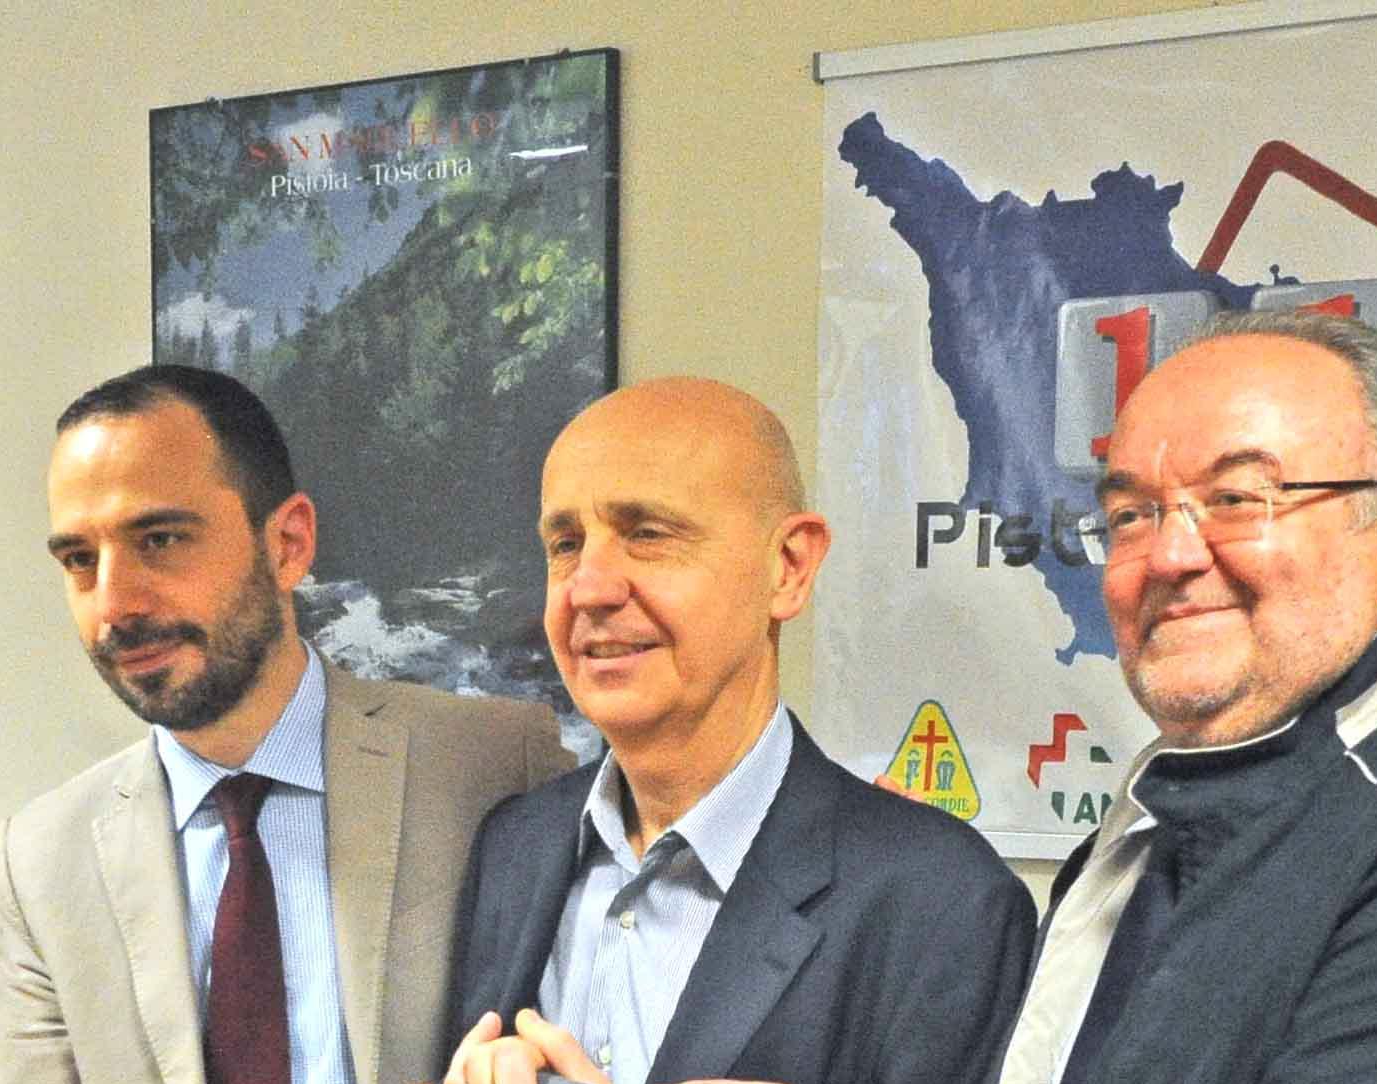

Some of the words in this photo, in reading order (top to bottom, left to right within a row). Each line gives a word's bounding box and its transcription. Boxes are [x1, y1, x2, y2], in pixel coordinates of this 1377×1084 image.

[270, 170, 349, 198] Pistoia
[369, 156, 473, 187] Toscana
[915, 499, 1091, 569] Pist
